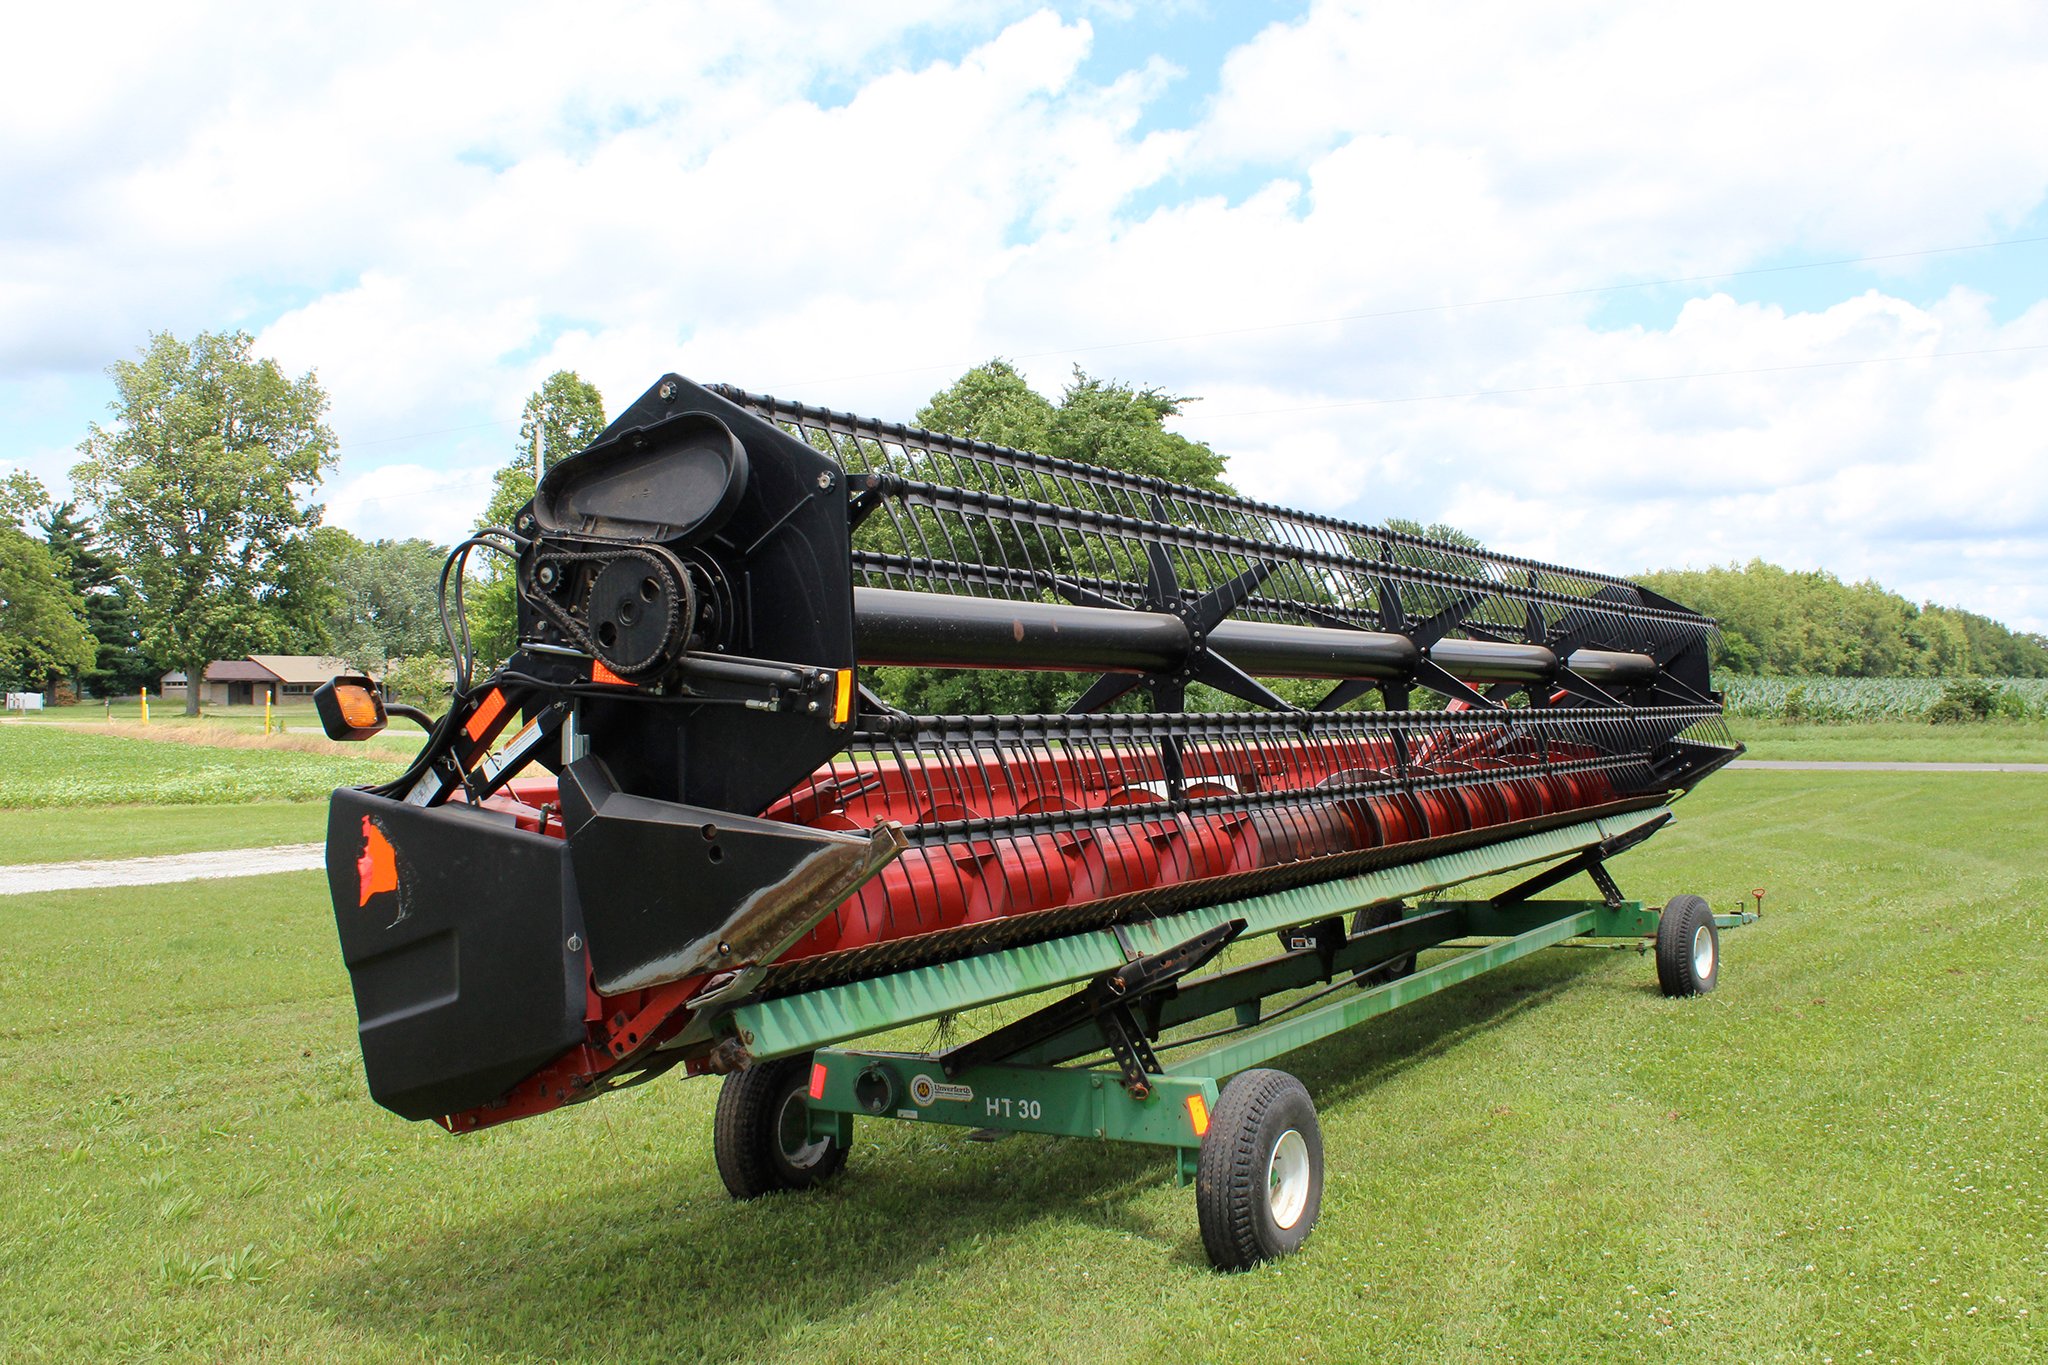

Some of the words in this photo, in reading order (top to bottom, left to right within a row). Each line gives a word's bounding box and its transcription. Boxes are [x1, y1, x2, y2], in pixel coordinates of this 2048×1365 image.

[934, 1084, 971, 1094] Unverferth
[986, 1097, 1012, 1118] HT
[1018, 1100, 1041, 1119] 30
